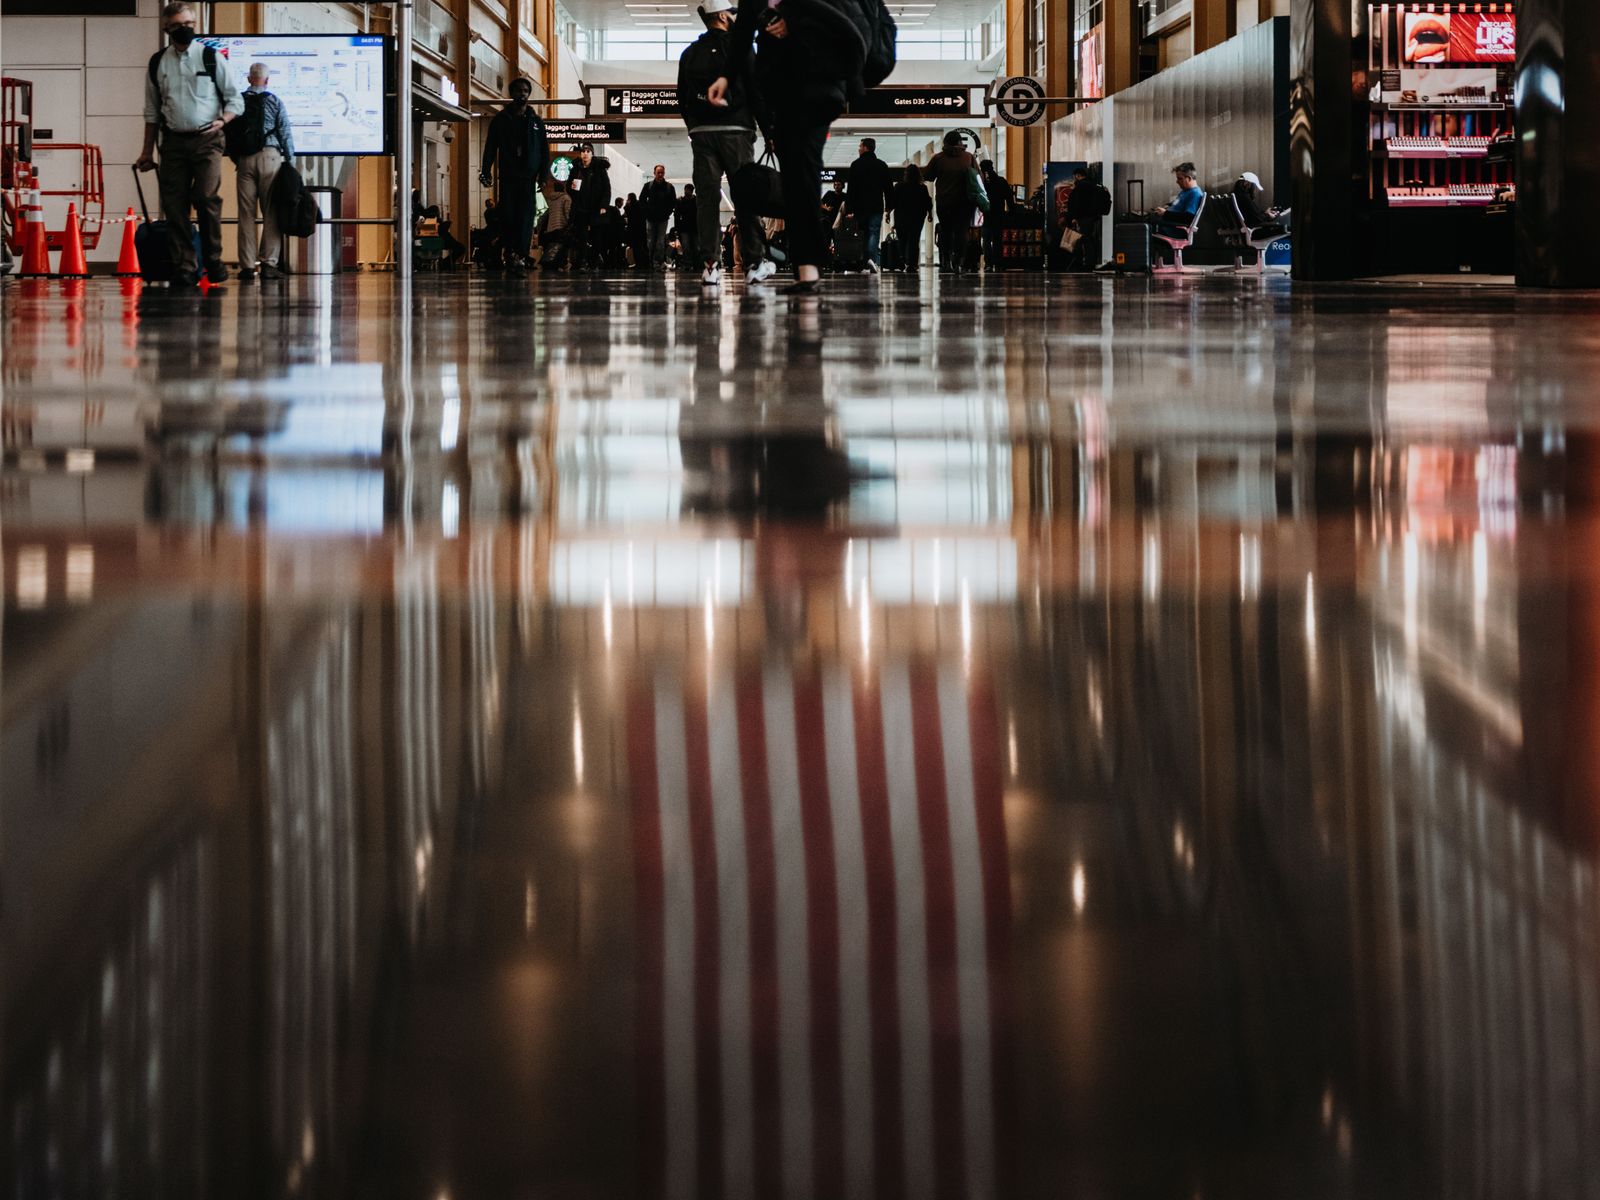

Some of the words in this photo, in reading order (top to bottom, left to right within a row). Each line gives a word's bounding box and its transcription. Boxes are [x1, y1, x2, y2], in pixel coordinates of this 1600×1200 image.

[1476, 26, 1515, 44] LIPS
[1012, 89, 1034, 114] D
[570, 123, 587, 131] Claim
